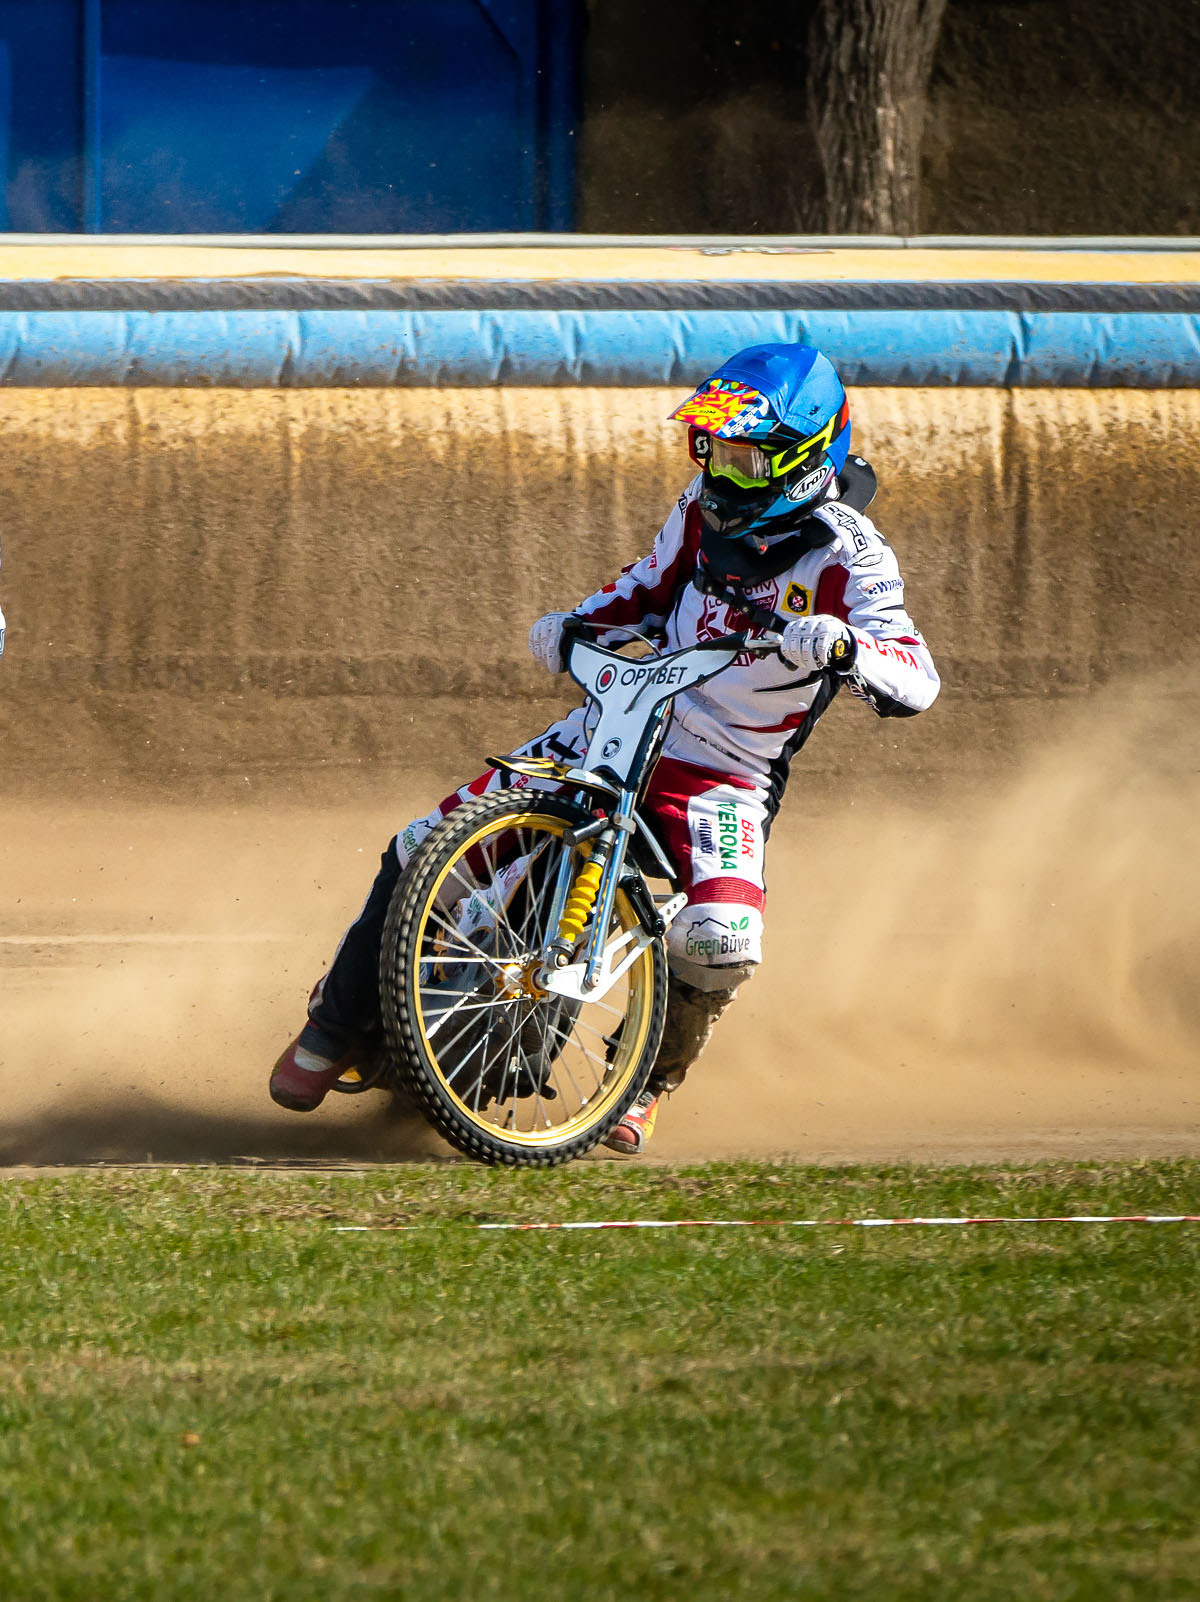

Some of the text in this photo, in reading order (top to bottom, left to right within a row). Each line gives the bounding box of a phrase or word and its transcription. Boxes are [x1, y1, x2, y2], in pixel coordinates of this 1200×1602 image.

[620, 666, 688, 686] OPTIBET
[716, 802, 738, 871] VERONA
[741, 818, 755, 859] BAR
[685, 934, 751, 956] GreenBūve
